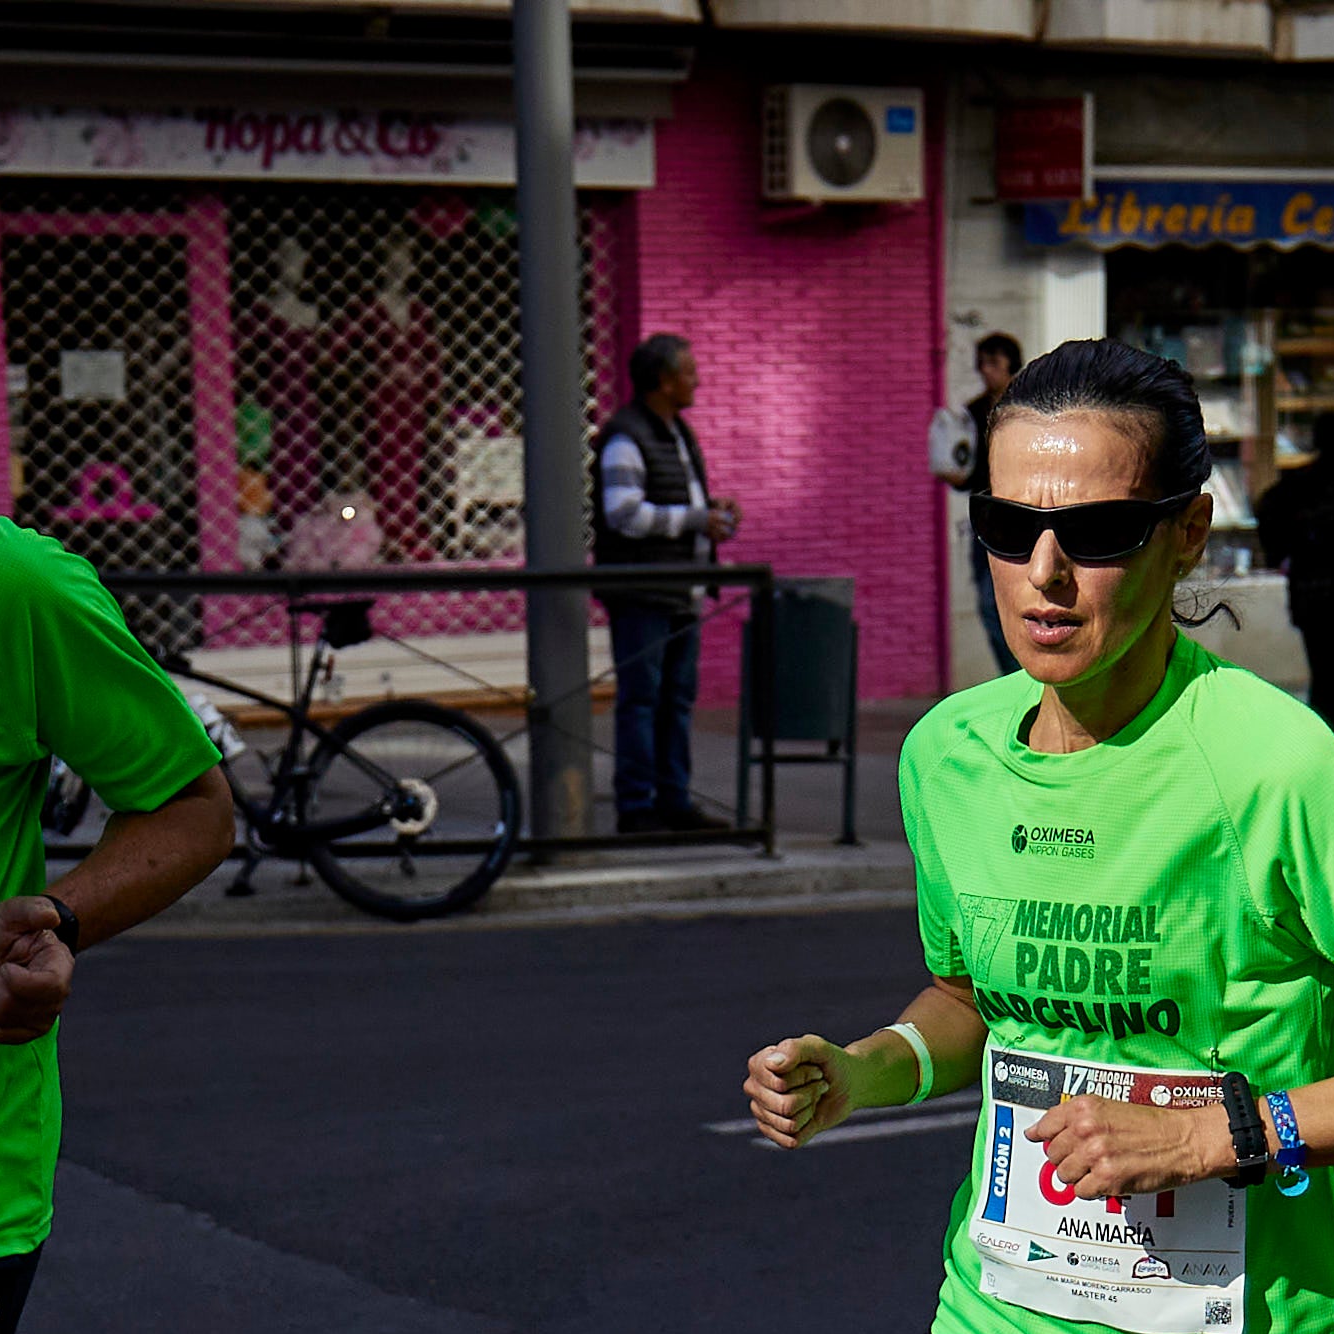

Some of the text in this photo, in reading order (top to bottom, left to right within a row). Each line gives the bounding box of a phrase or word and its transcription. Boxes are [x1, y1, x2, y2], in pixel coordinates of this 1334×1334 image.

[1060, 189, 1257, 237] Librería
[1030, 826, 1095, 845] OXIMESA
[1028, 844, 1095, 859] NIPPON GASES
[1011, 899, 1161, 943] MEMORIAL
[1015, 941, 1153, 996] PADRE
[1008, 1063, 1050, 1082] OXIMESA
[1062, 1065, 1088, 1096] 17
[1086, 1068, 1136, 1087] MEMORIAL
[1085, 1080, 1131, 1103] PADRE
[1172, 1085, 1225, 1098] OXIMES
[1172, 1098, 1205, 1107] NIPPON
[993, 1126, 1012, 1198] CAJÓN 2
[1057, 1217, 1156, 1247] ANA MARÍA
[979, 1235, 1020, 1252] CALERO
[1080, 1254, 1121, 1267] OXIMESA
[1046, 1275, 1059, 1283] ANA
[1081, 1280, 1110, 1291] MORENO
[1110, 1285, 1152, 1295] CARRASCO
[1071, 1288, 1118, 1303] MASTER 45
